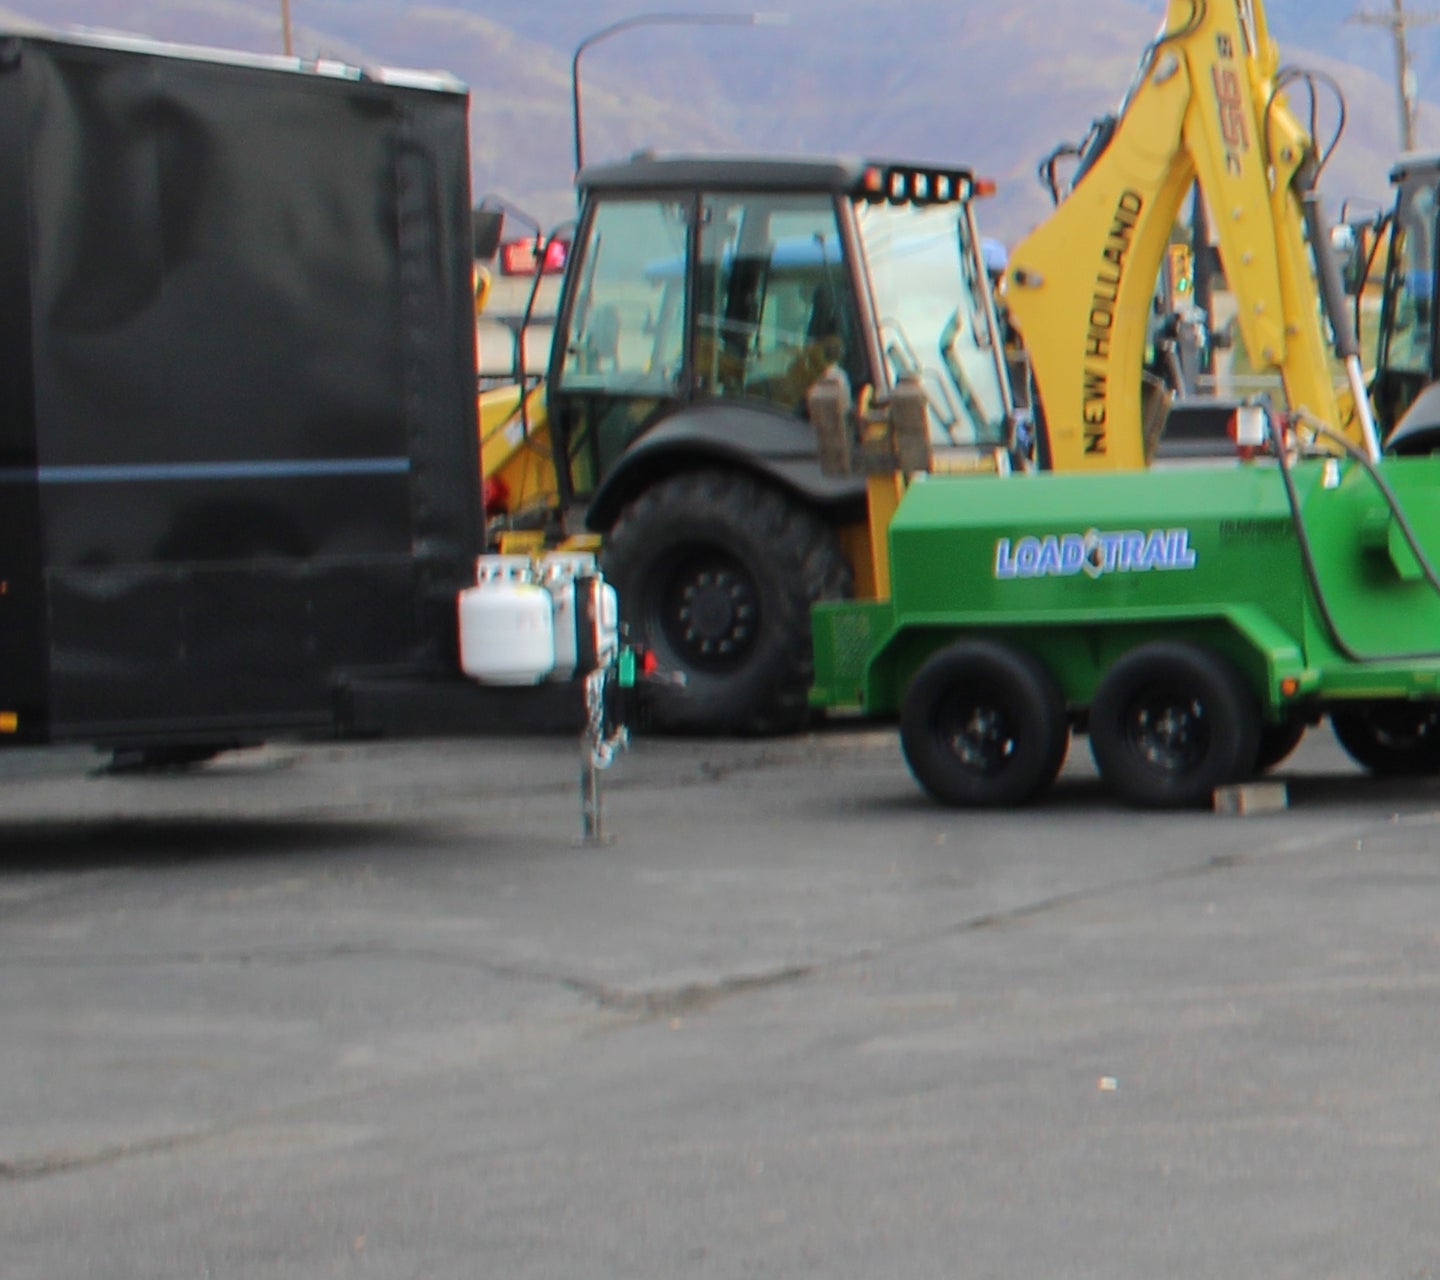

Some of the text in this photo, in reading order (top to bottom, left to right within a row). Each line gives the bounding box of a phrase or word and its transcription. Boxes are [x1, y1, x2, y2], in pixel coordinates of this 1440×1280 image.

[1084, 190, 1143, 455] NEW HOLLAND
[994, 528, 1199, 580] LOAD TRAIL
